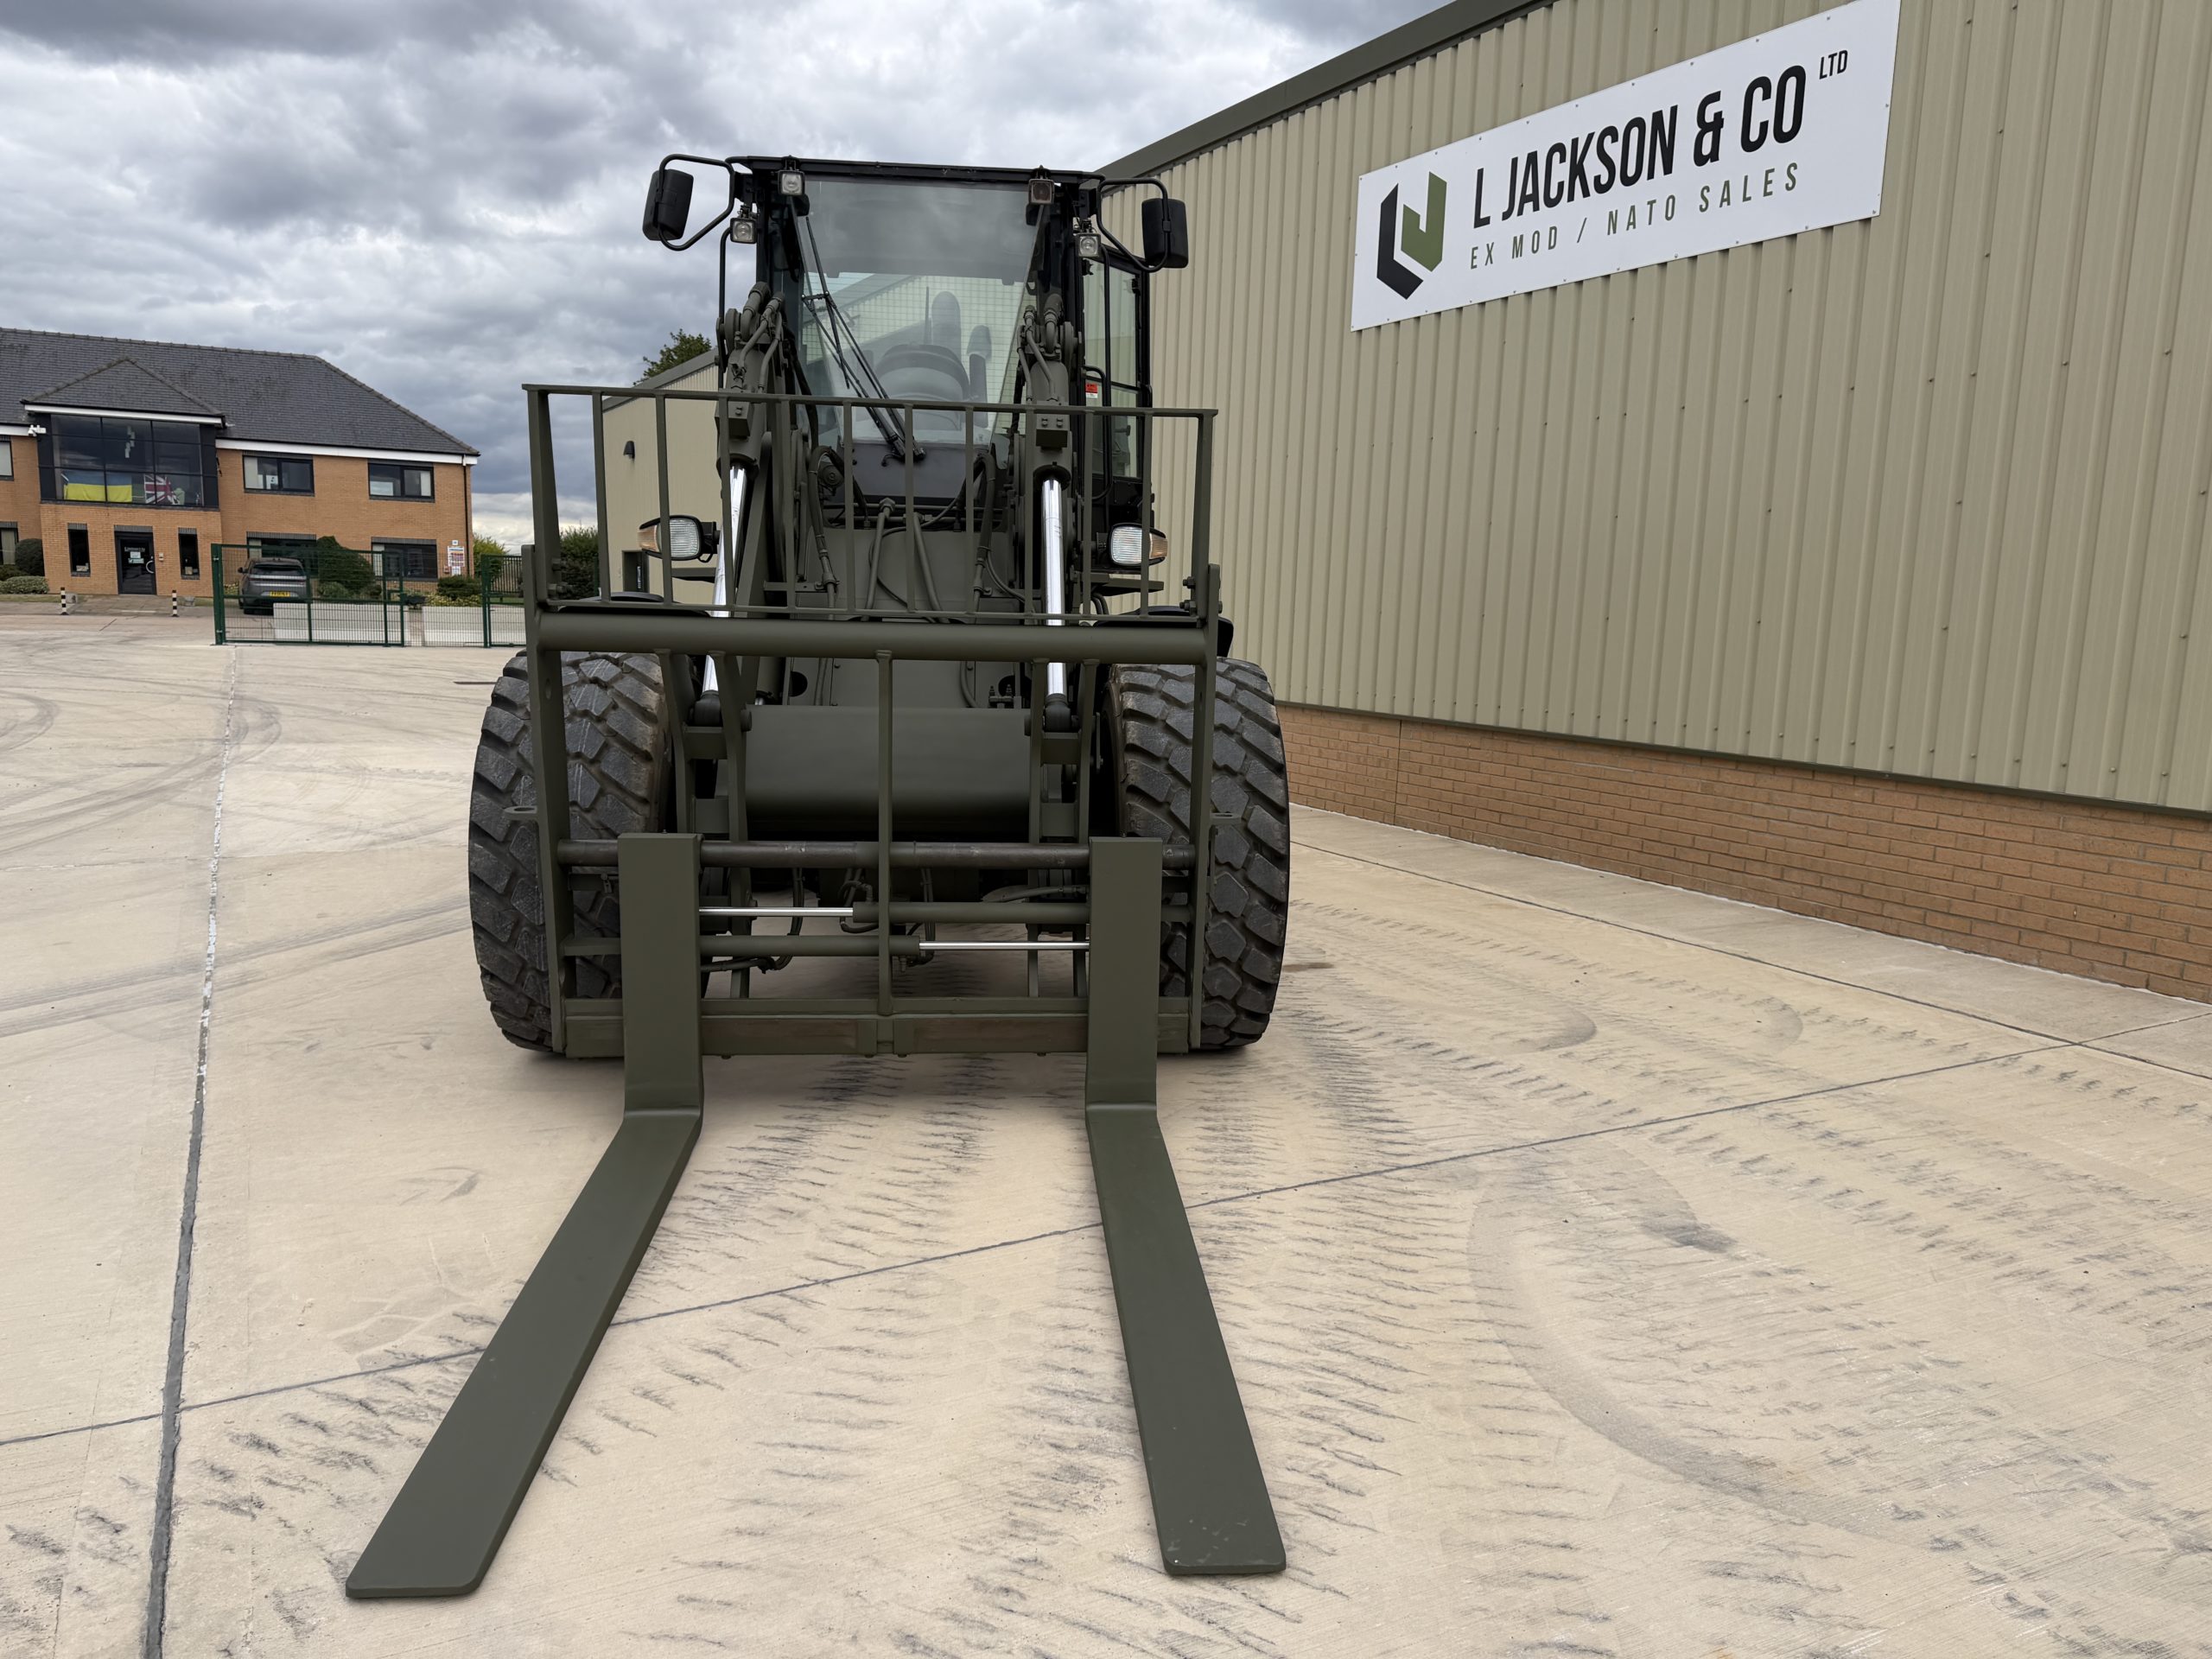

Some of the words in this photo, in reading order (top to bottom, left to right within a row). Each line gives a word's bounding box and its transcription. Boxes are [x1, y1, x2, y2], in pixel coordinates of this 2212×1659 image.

[1473, 167, 1491, 229] L
[1501, 104, 1679, 222] JACKSON
[1693, 90, 1725, 168] &
[1740, 64, 1807, 154] CO
[1819, 49, 1848, 80] LTD
[1470, 241, 1495, 270] EX
[1511, 225, 1558, 260] MOD
[1607, 194, 1676, 236] NATO
[1699, 162, 1798, 213] SALES
